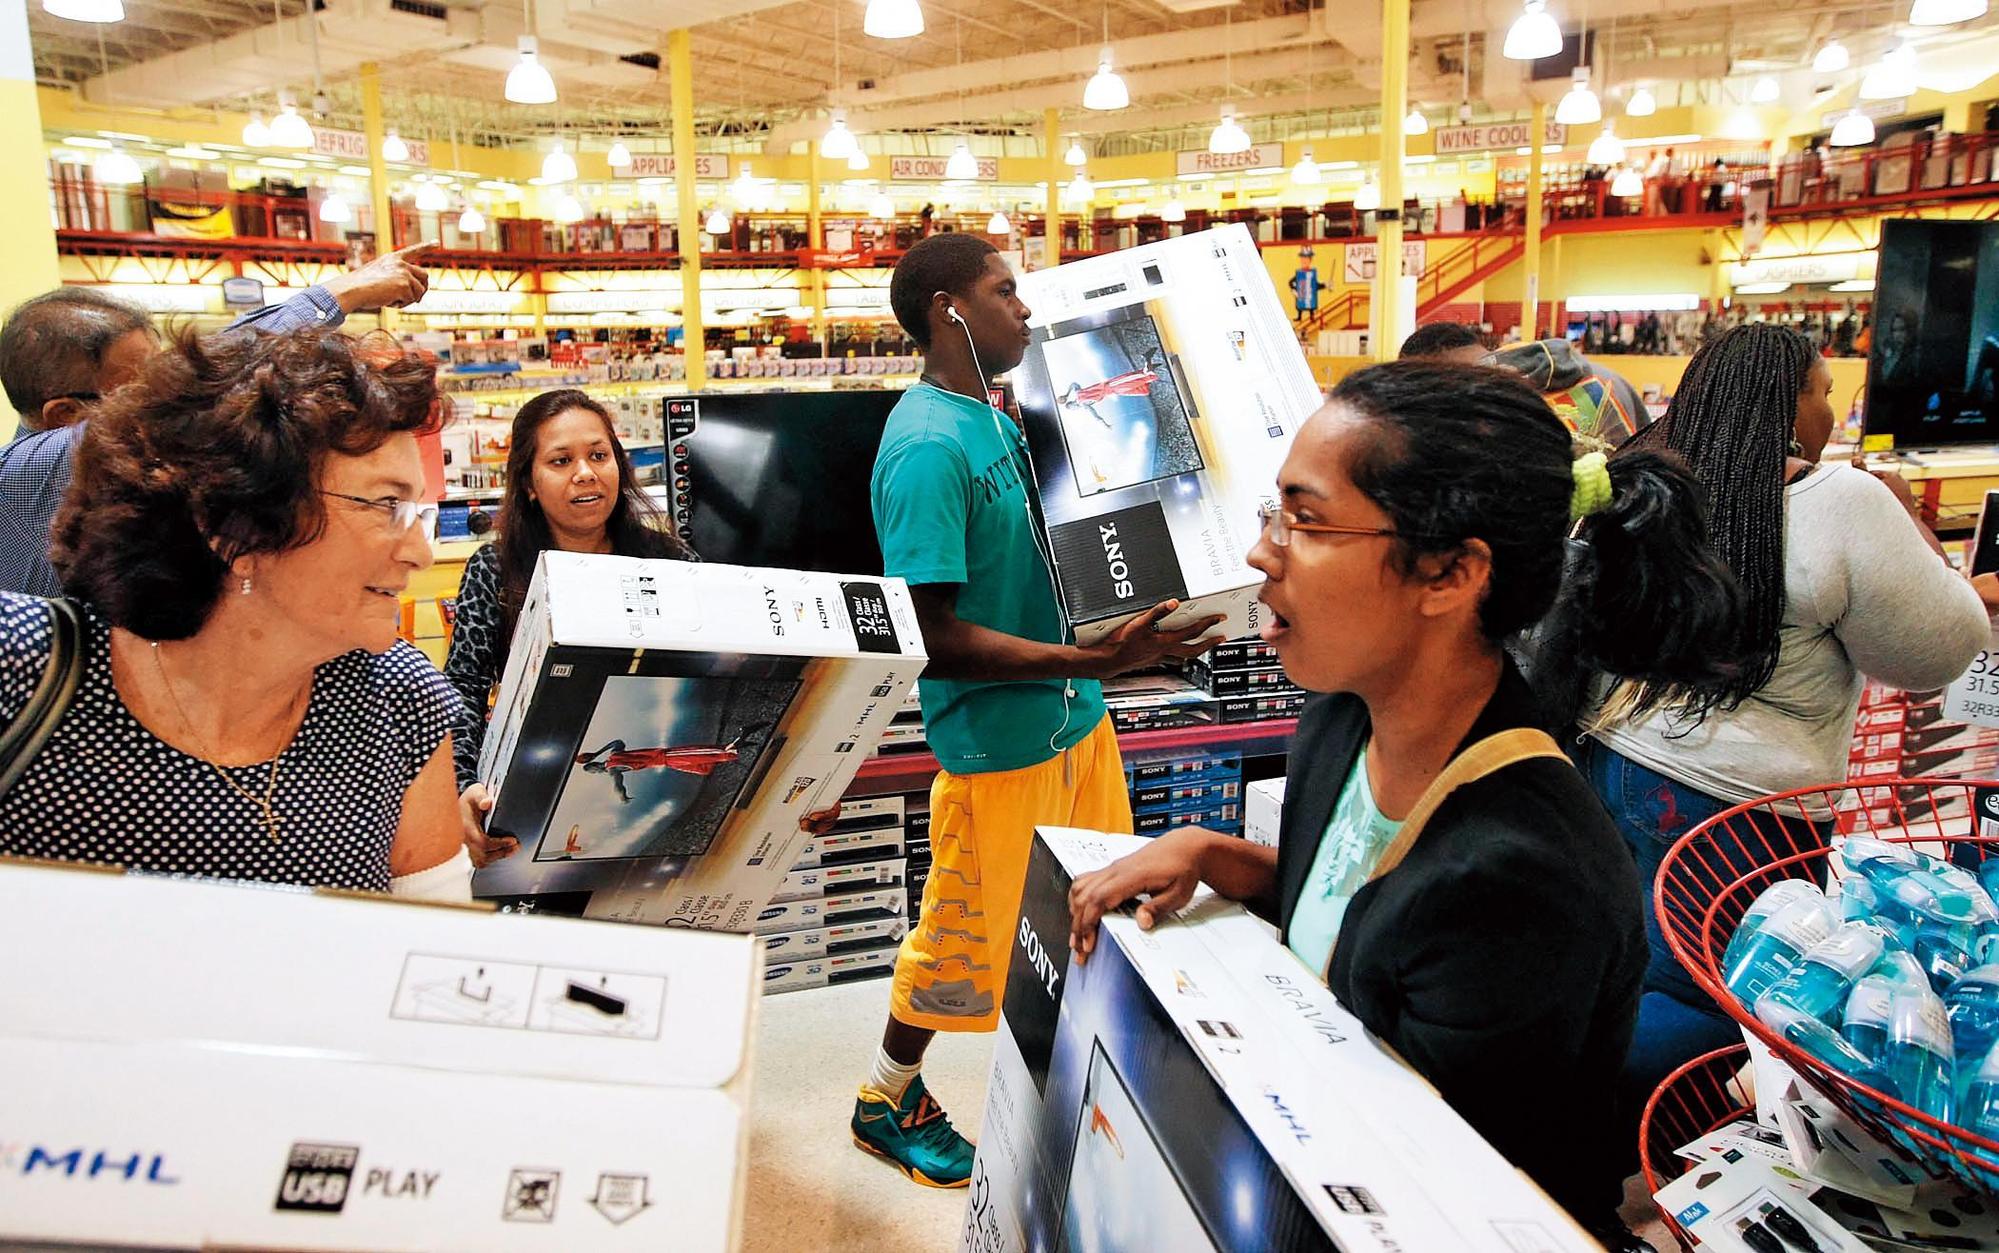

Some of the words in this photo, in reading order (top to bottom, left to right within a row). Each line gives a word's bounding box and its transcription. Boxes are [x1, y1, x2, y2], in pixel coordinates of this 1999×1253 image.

[1442, 129, 1480, 147] WINE
[1488, 124, 1560, 145] COOLRS
[632, 158, 711, 174] APPLIAES
[893, 160, 911, 175] AIR
[1197, 149, 1260, 169] FREEZERS
[1201, 528, 1224, 576] BRAVIA
[764, 585, 785, 637] SONY
[1248, 600, 1258, 629] SONY
[856, 616, 878, 636] 32
[1217, 676, 1241, 684] SONY
[1142, 766, 1166, 774] SONY
[1141, 792, 1165, 800] SONY
[1140, 818, 1164, 826] SONY
[1265, 975, 1347, 1044] BRAVIA
[993, 1060, 1015, 1121] BRAVIA
[23, 1147, 180, 1184] MHL
[282, 1170, 348, 1204] USB
[363, 1168, 441, 1197] PLAY
[972, 1157, 990, 1233] 32
